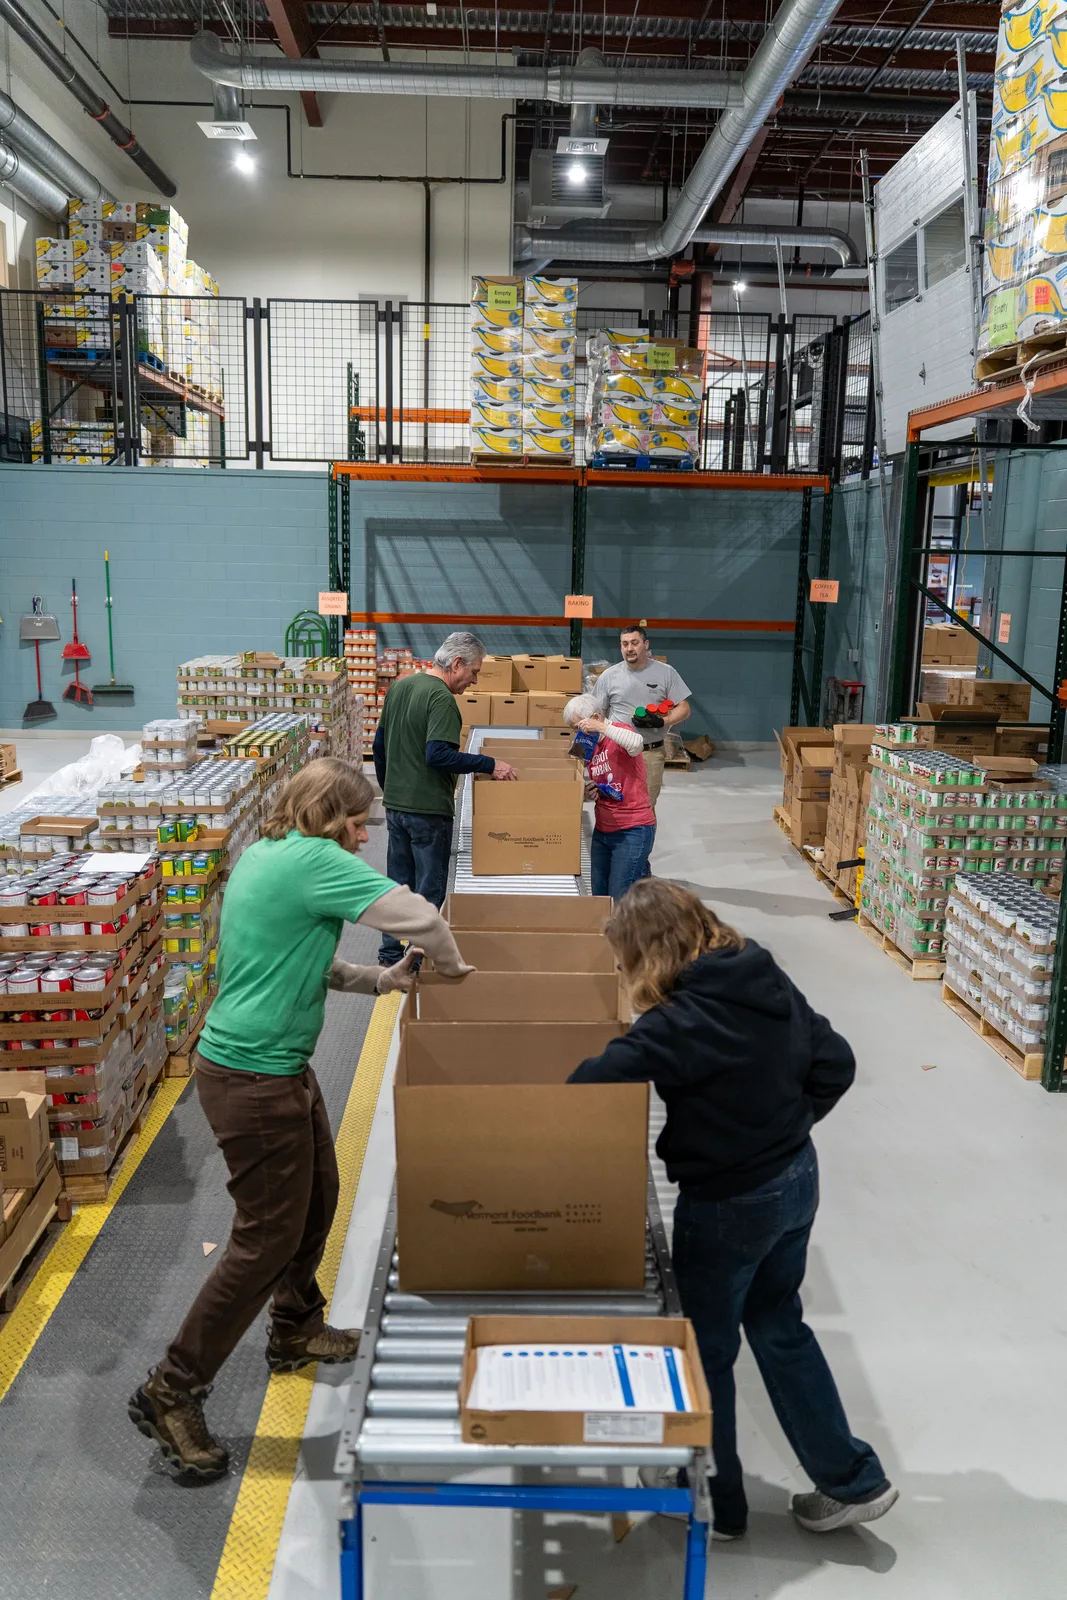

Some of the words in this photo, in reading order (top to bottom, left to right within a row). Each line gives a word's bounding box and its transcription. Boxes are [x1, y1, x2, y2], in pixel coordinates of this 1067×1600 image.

[994, 303, 1008, 314] Empty
[993, 324, 1008, 333] Boxes
[466, 1211, 509, 1220] Vermont
[512, 1210, 562, 1219] Foodbank
